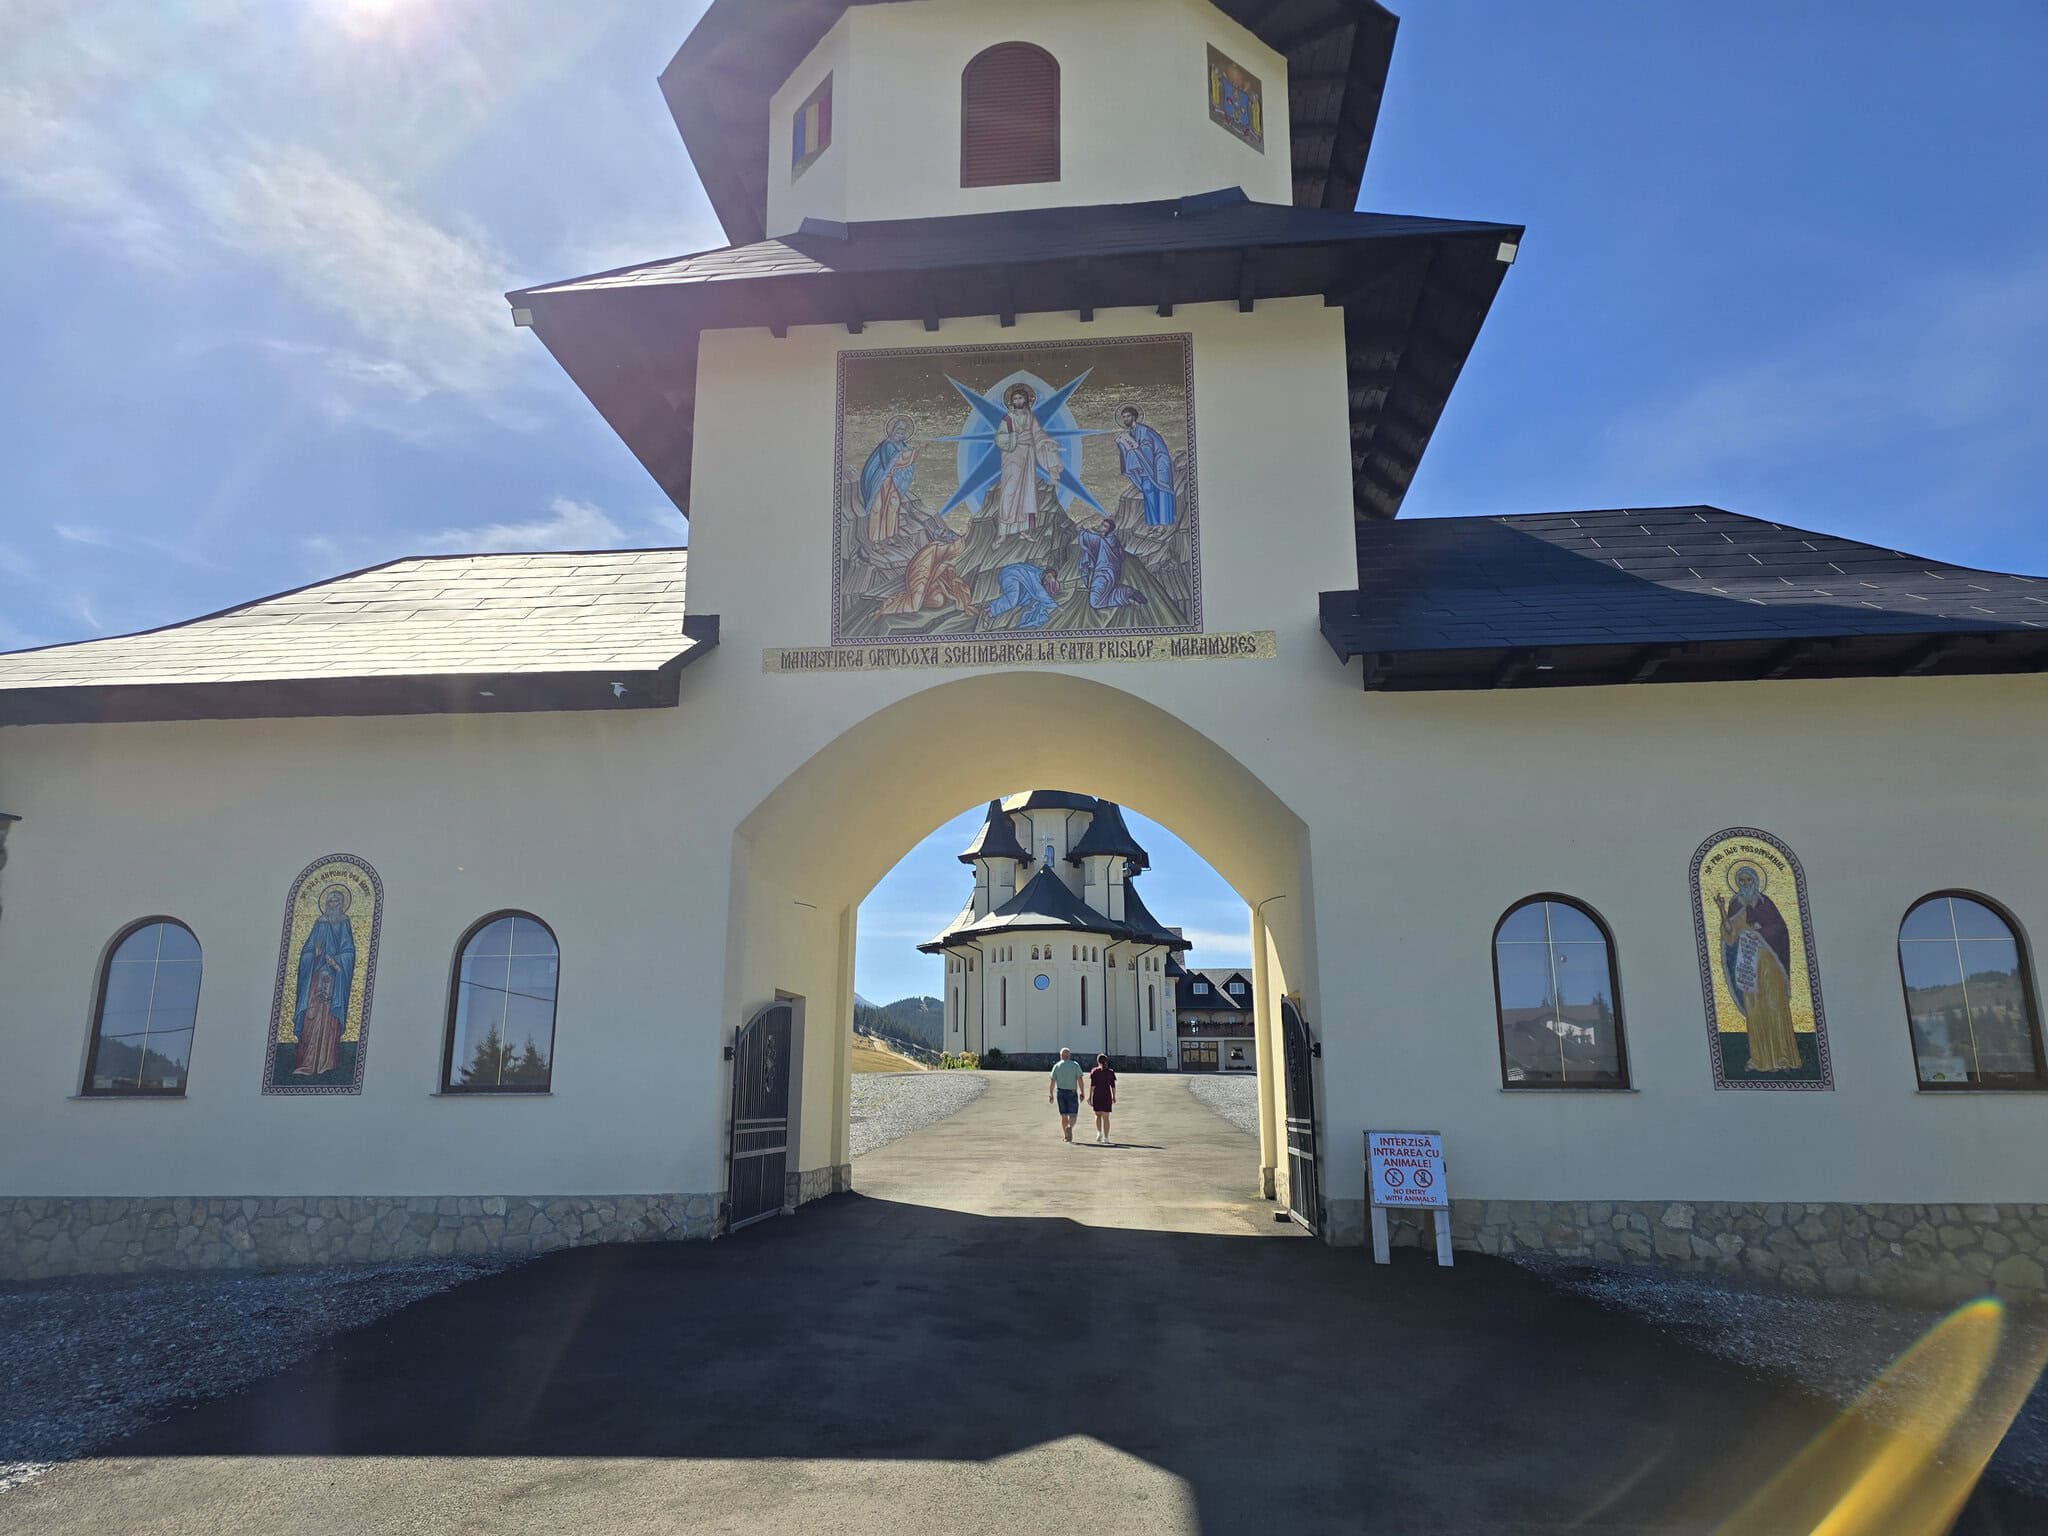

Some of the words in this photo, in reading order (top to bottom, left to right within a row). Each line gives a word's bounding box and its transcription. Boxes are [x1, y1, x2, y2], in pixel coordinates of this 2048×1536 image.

[781, 649, 863, 669] MANASTIREA
[869, 647, 938, 666] ORTODOXA
[944, 643, 1033, 664] SCHIMBAREA
[1038, 642, 1055, 661] LA
[1099, 639, 1154, 659] PRISLOP
[1374, 1147, 1424, 1157] INTRAREA
[1425, 1149, 1440, 1158] CU
[1383, 1158, 1432, 1168] ANIMALE!
[1385, 1194, 1403, 1202] WITH
[1404, 1195, 1437, 1203] ANIMALS!
